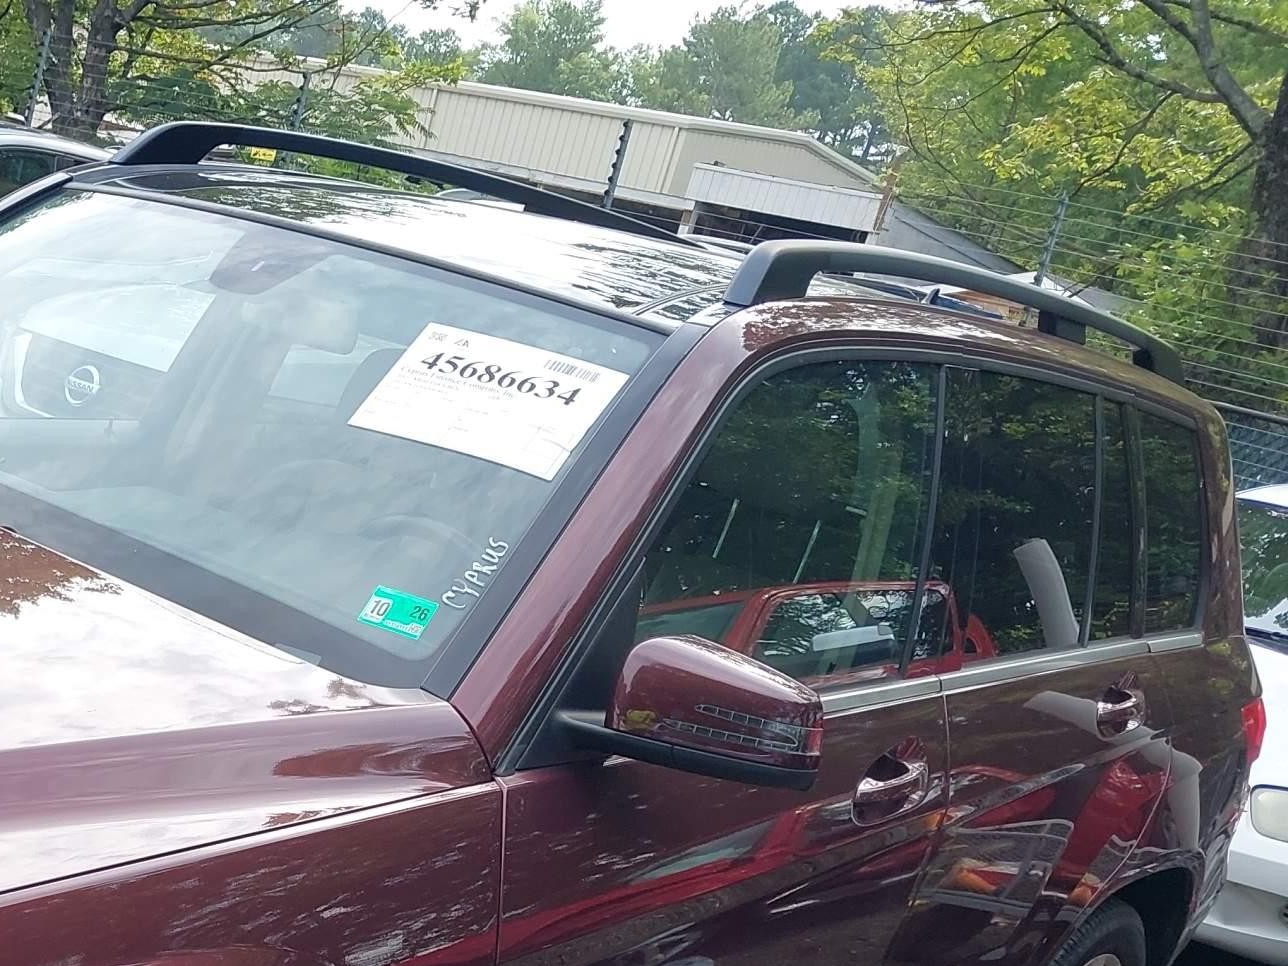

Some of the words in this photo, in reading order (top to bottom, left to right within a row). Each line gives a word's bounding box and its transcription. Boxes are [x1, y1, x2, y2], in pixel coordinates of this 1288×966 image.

[421, 352, 582, 406] 45686634
[441, 536, 509, 609] CYPRUS
[370, 599, 391, 617] 10
[409, 605, 430, 621] 26
